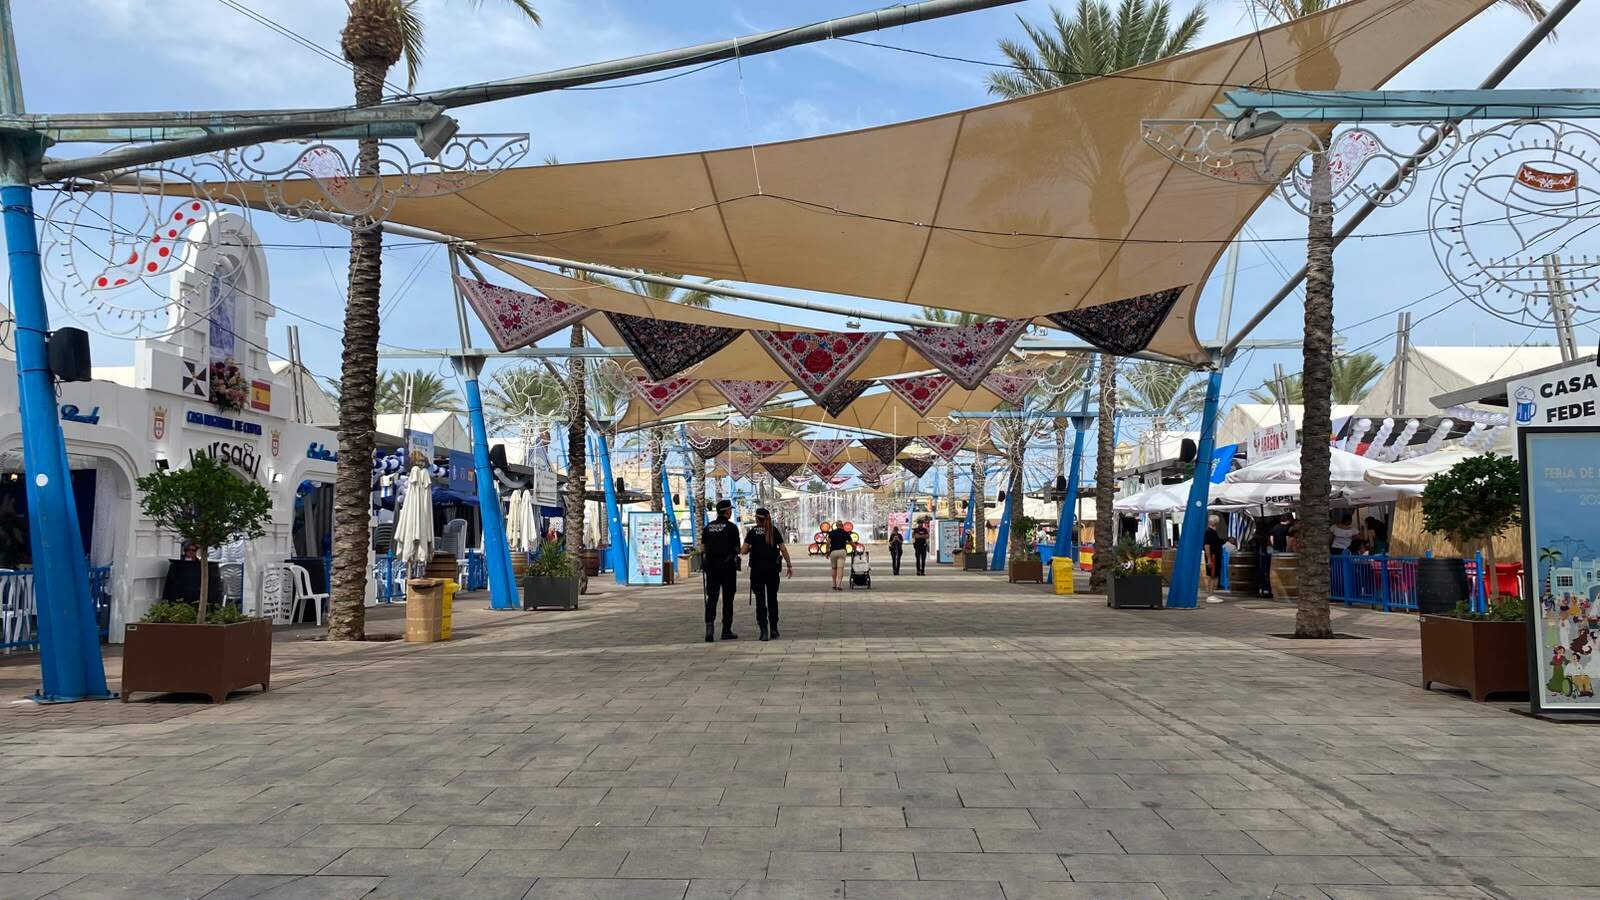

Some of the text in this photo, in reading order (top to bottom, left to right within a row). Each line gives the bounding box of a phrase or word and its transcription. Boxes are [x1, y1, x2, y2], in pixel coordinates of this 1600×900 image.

[1540, 374, 1598, 398] CASA
[1546, 400, 1596, 423] FEDE
[1580, 467, 1594, 478] DE
